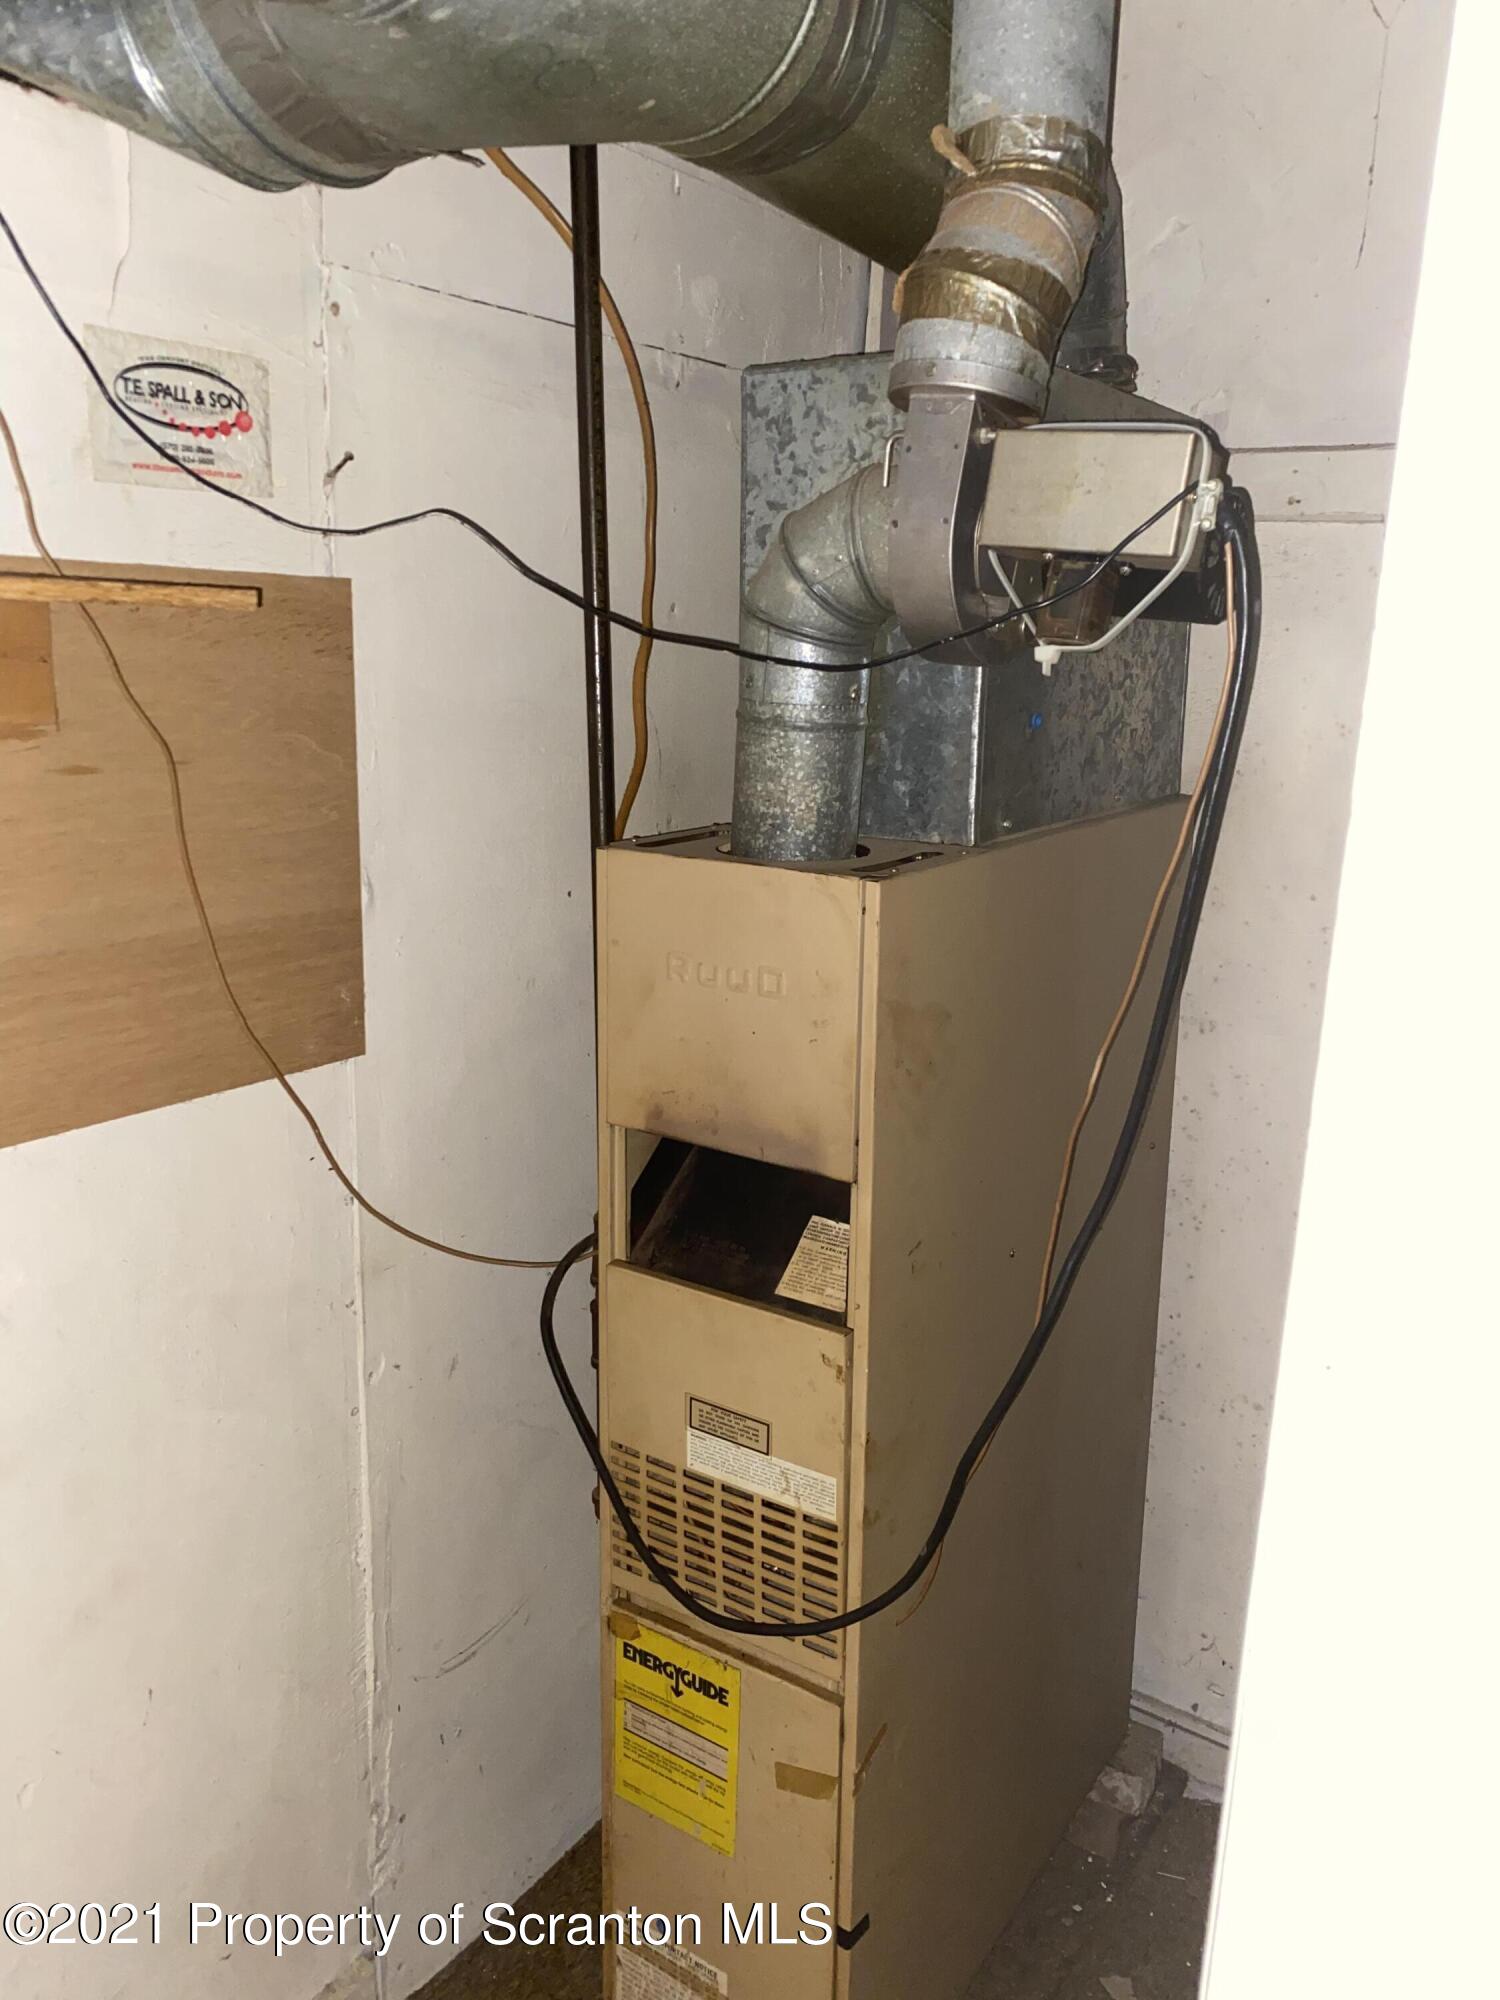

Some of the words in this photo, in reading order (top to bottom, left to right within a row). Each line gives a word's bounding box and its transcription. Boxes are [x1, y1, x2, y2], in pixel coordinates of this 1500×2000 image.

[147, 381, 191, 405] SPALL
[194, 389, 206, 406] &
[208, 390, 243, 411] SON
